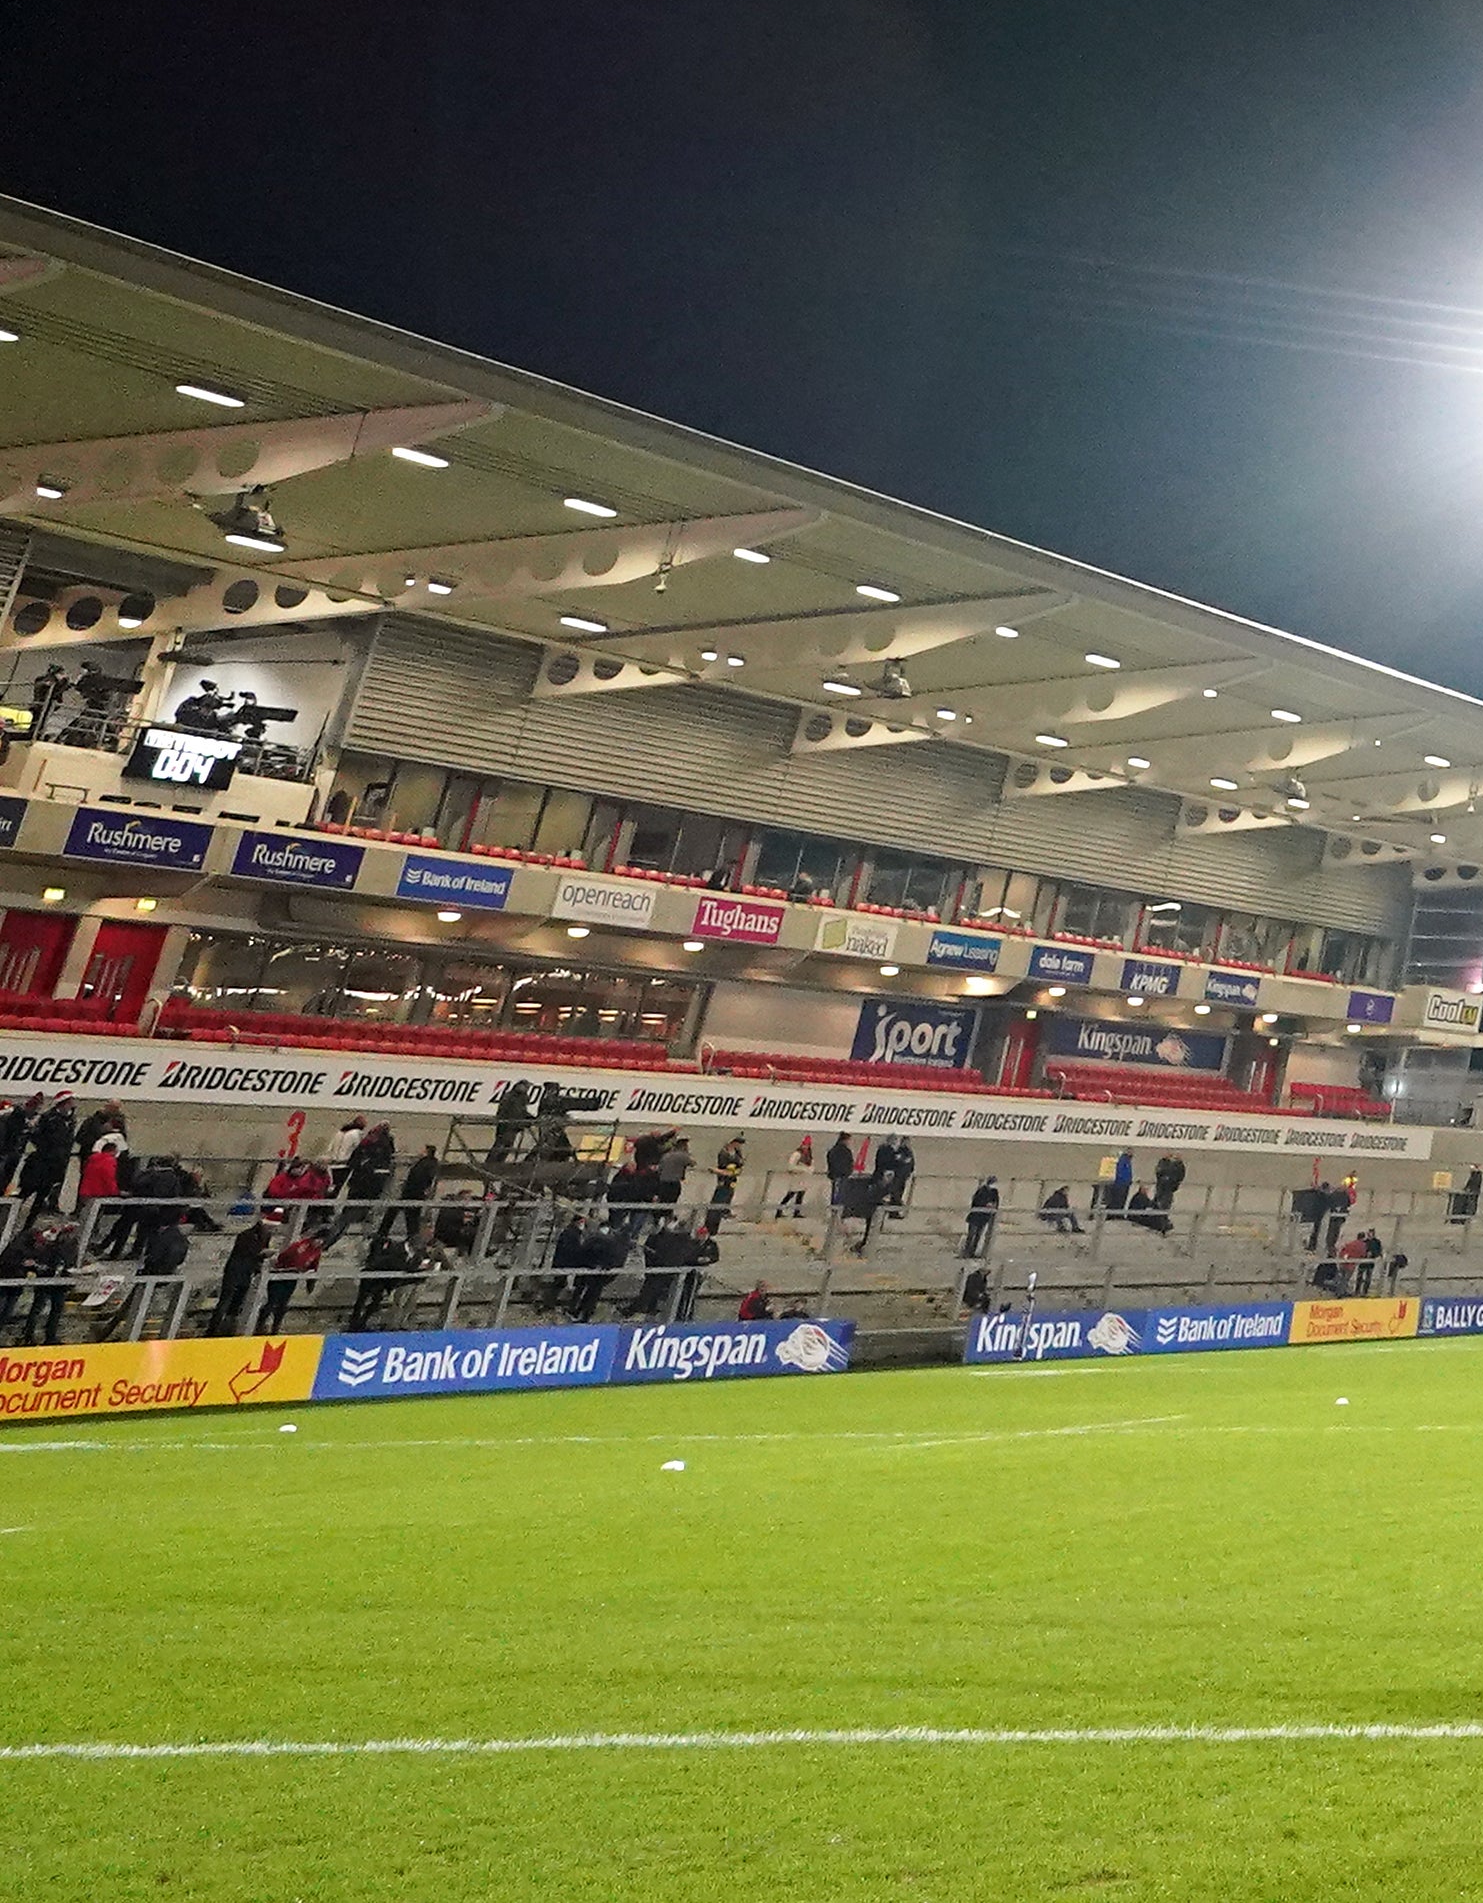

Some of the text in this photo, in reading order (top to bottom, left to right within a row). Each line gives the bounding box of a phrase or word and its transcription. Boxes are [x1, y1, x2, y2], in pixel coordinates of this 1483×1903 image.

[87, 821, 182, 853] Rushmere
[252, 843, 336, 875] Rushmere
[421, 870, 505, 896] Bank of Ireland
[562, 882, 652, 913] openreach
[701, 900, 779, 936] Tughans
[1129, 975, 1169, 994] KPMG
[1077, 1023, 1153, 1062] Kingspan
[158, 1060, 328, 1095] BRIDGESTONE
[334, 1070, 483, 1103] BRIDGESTONE
[625, 1087, 745, 1117] BRIDGESTONE
[749, 1095, 856, 1122] BRIDGESTONE
[860, 1101, 956, 1128] BRIDGESTONE
[960, 1108, 1049, 1133] BRIDGESTONE
[1052, 1113, 1132, 1137] BRIDGESTONE
[1136, 1119, 1211, 1141] BRIDGESTONE
[1178, 1311, 1283, 1344] Bank of Ireland
[382, 1337, 601, 1386] Bank of Ireland
[625, 1323, 766, 1380] Kingspan
[108, 1376, 209, 1407] Security
